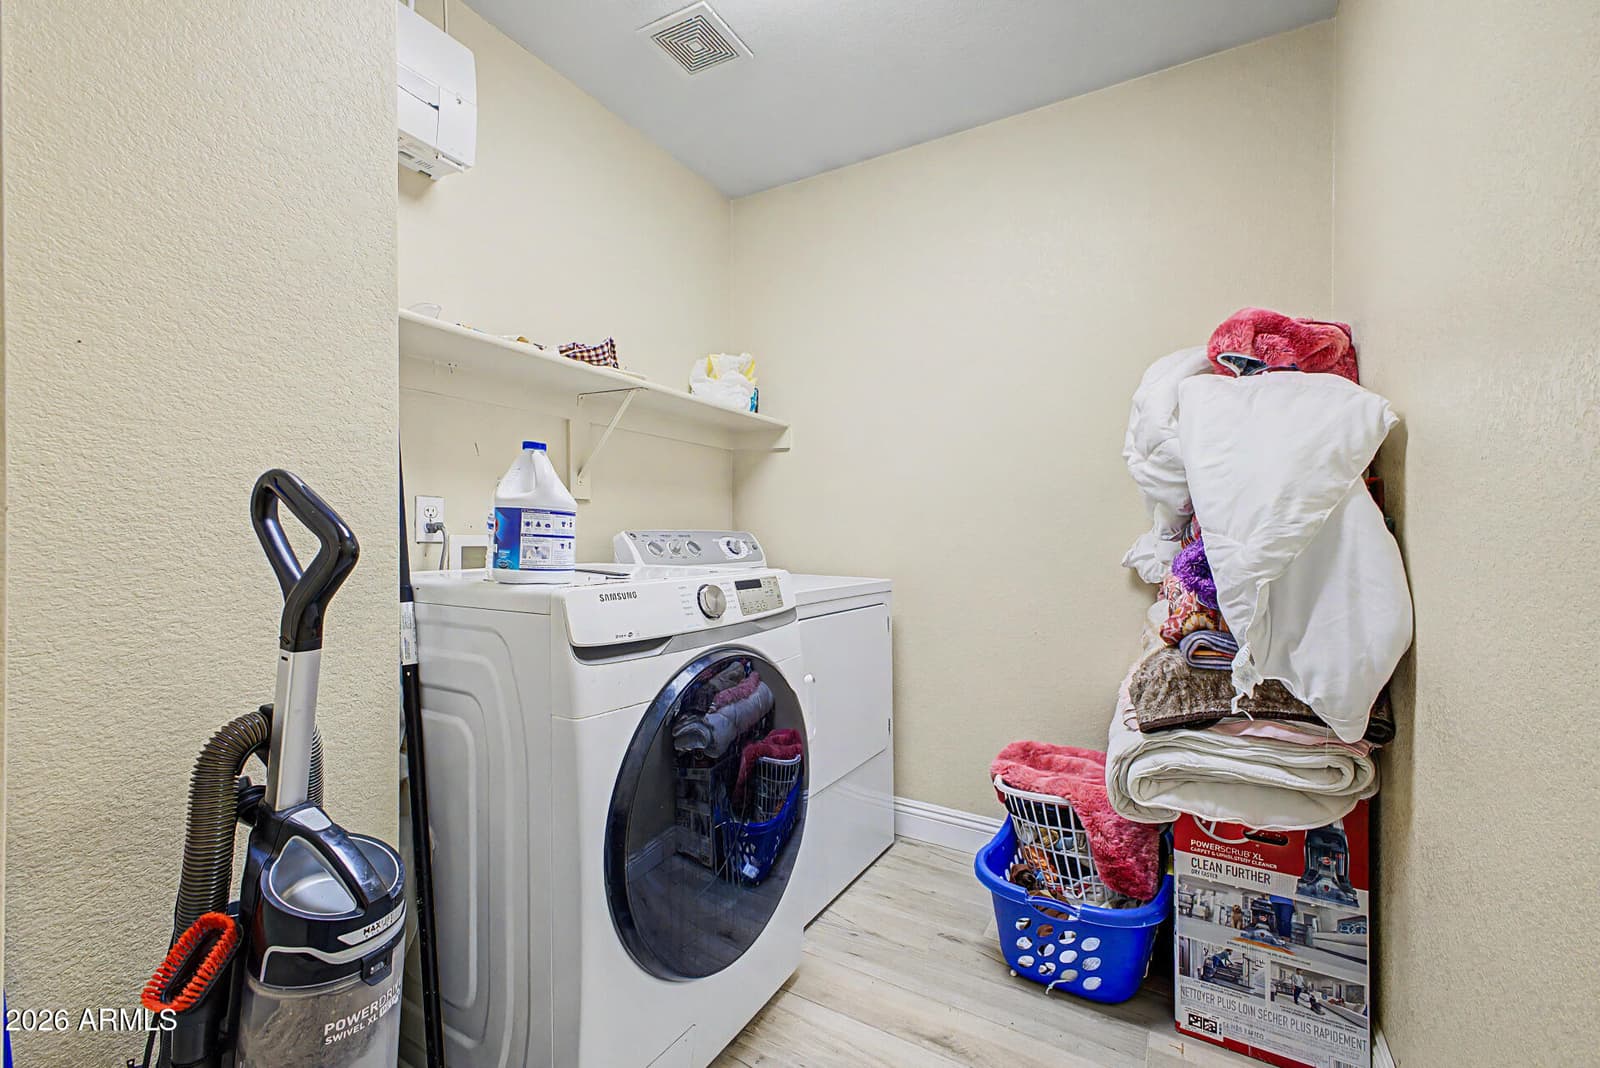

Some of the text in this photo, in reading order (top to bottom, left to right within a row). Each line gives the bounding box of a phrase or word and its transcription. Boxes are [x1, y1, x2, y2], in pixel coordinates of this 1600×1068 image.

[599, 591, 638, 602] SAMSUNG
[1190, 839, 1264, 862] POWERSCRUB XL
[1191, 857, 1271, 885] CLEAN FURTHER
[325, 1012, 379, 1046] SWIVEL XL
[1181, 986, 1215, 1005] NETTOYER
[1217, 995, 1237, 1011] PLUS
[1238, 1001, 1256, 1017] LOIN
[1257, 1008, 1288, 1026] SÉCHER
[1290, 1018, 1311, 1034] PLUS
[1313, 1025, 1367, 1052] RAPIDEMENT
